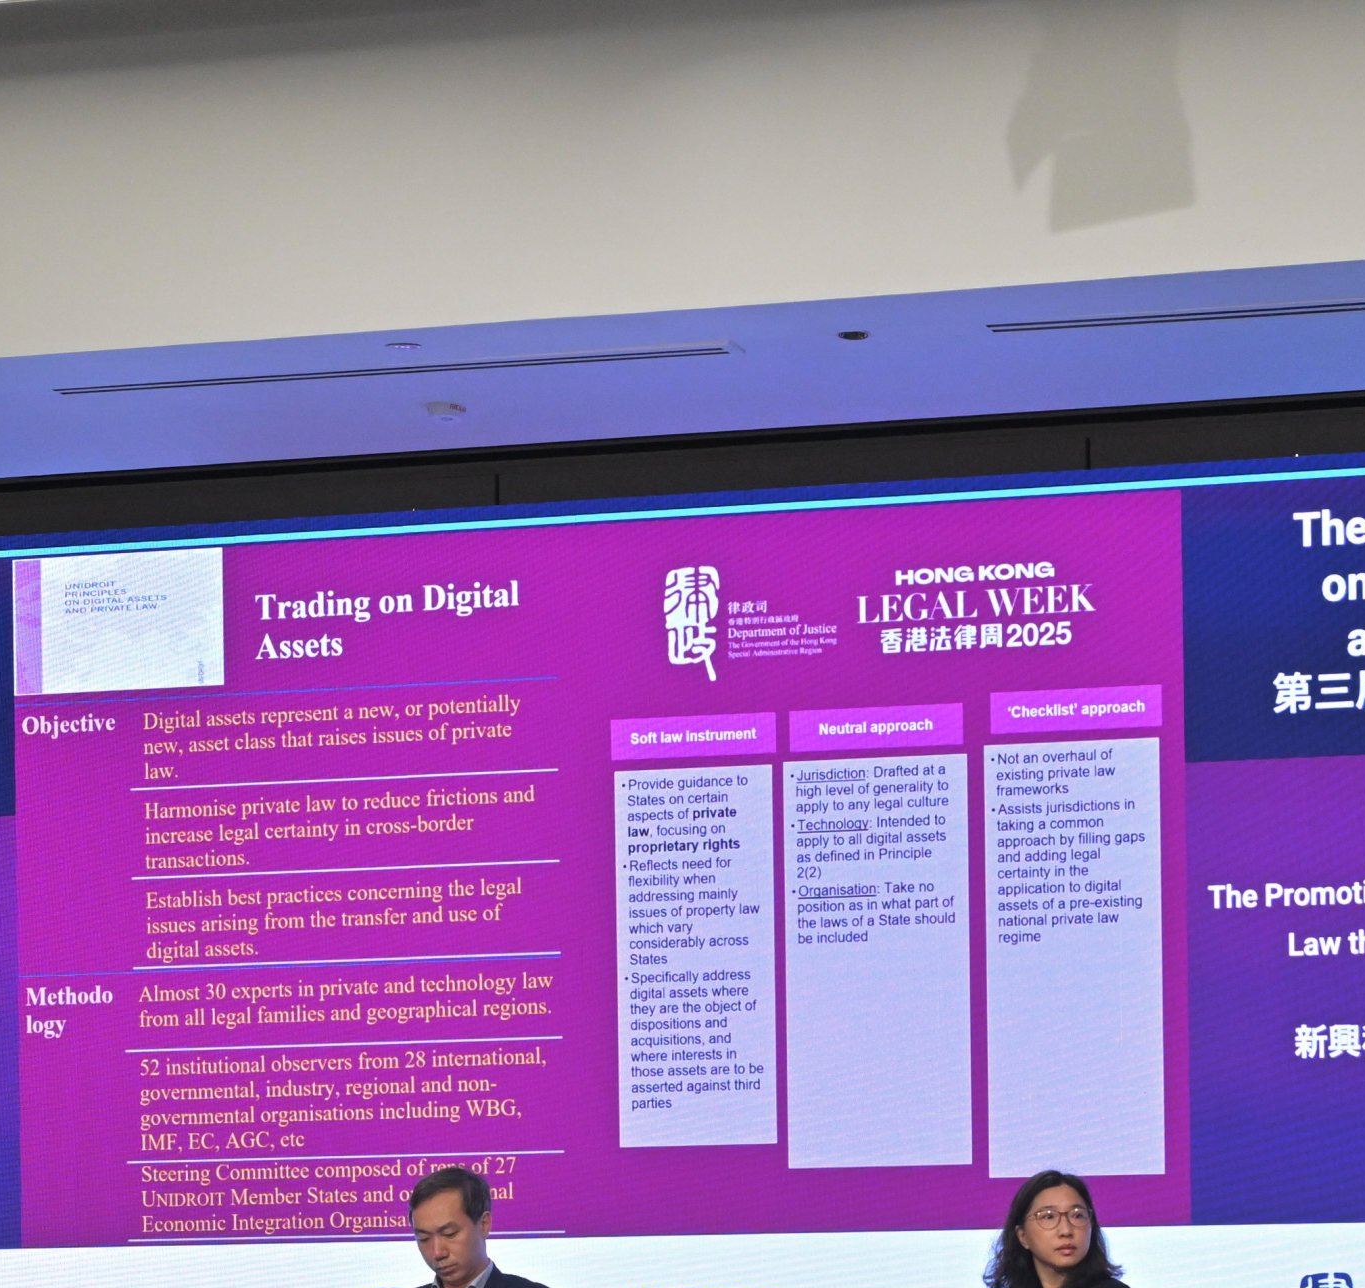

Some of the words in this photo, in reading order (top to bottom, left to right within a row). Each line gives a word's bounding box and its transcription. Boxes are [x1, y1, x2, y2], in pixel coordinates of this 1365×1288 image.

[895, 566, 974, 586] HONG
[978, 561, 1055, 581] KONG
[255, 590, 371, 622] Trading
[379, 594, 413, 614] on
[423, 580, 519, 617] Digital
[728, 600, 767, 615] 律政司
[858, 591, 978, 624] LEGAL
[986, 584, 1095, 617] WEEK
[728, 627, 786, 640] Department
[789, 624, 801, 635] of
[803, 624, 837, 635] Justice
[880, 621, 1072, 654] 香港法律周2025
[255, 633, 343, 660] Assets
[143, 710, 201, 734] Digital
[206, 711, 255, 726] assets
[261, 706, 338, 728] represent
[344, 708, 353, 720] a
[359, 706, 399, 720] new,
[405, 704, 423, 716] or
[428, 694, 520, 720] potentially
[22, 713, 115, 739] Objective
[630, 731, 657, 745] Soft
[660, 731, 683, 743] law
[686, 727, 757, 742] instrument
[819, 721, 867, 735] Neutral
[870, 718, 933, 735] approach
[144, 741, 183, 755] new,
[189, 737, 230, 752] asset
[235, 732, 276, 750] class
[281, 730, 313, 748] that
[318, 728, 367, 746] raises
[372, 726, 423, 744] issues
[428, 722, 449, 741] of
[451, 721, 512, 745] private
[997, 753, 1019, 765] Not
[1023, 754, 1039, 764] an
[1042, 749, 1096, 763] overhaul
[1100, 748, 1113, 760] of
[144, 762, 178, 780] law.
[996, 768, 1044, 782] existing
[1048, 766, 1090, 781] private
[1094, 765, 1116, 777] law
[628, 778, 674, 790] Provide
[677, 776, 733, 791] guidance
[736, 774, 748, 786] to
[996, 782, 1069, 796] frameworks
[627, 795, 665, 807] States
[669, 795, 684, 805] on
[687, 791, 728, 804] certain
[627, 809, 674, 823] aspects
[677, 808, 689, 820] of
[693, 806, 737, 821] private
[628, 826, 652, 838] law,
[656, 824, 707, 837] focusing
[710, 825, 726, 834] on
[628, 841, 699, 856] proprietary
[703, 838, 740, 853] rights
[1207, 883, 1258, 909] The
[1288, 932, 1341, 956] Law
[26, 985, 113, 1006] Methodo
[139, 985, 200, 1002] Almost
[206, 983, 226, 1000] 30
[231, 984, 292, 1004] experts
[298, 979, 314, 997] in
[319, 978, 378, 1002] private
[384, 975, 415, 994] and
[420, 973, 516, 995] technology
[523, 971, 553, 989] law
[139, 1010, 179, 1027] from
[185, 1008, 205, 1026] all
[211, 1006, 251, 1030] legal
[258, 1004, 325, 1023] families
[330, 1003, 361, 1021] and
[366, 999, 477, 1025] geographical
[483, 997, 551, 1021] regions.
[26, 1015, 66, 1039] logy
